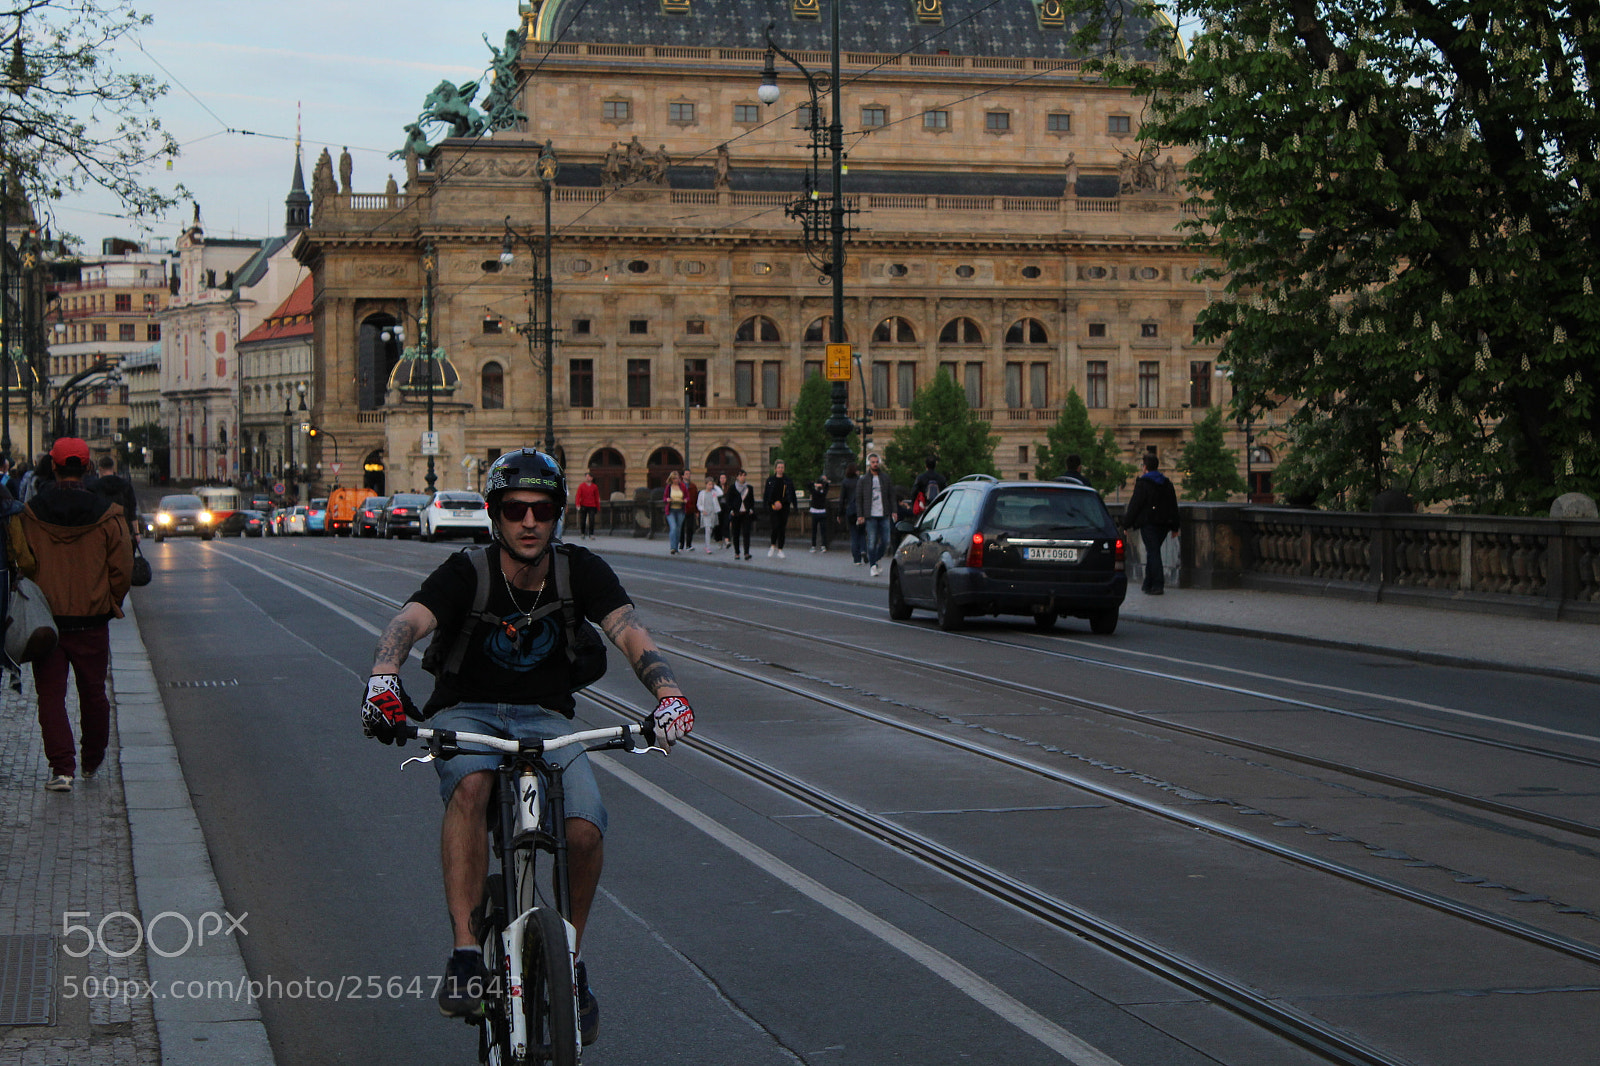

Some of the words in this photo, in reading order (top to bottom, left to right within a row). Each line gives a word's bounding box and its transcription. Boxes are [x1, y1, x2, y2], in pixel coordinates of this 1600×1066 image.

[519, 477, 541, 485] FREE
[1030, 550, 1047, 559] 3AY
[1052, 550, 1075, 559] 0960
